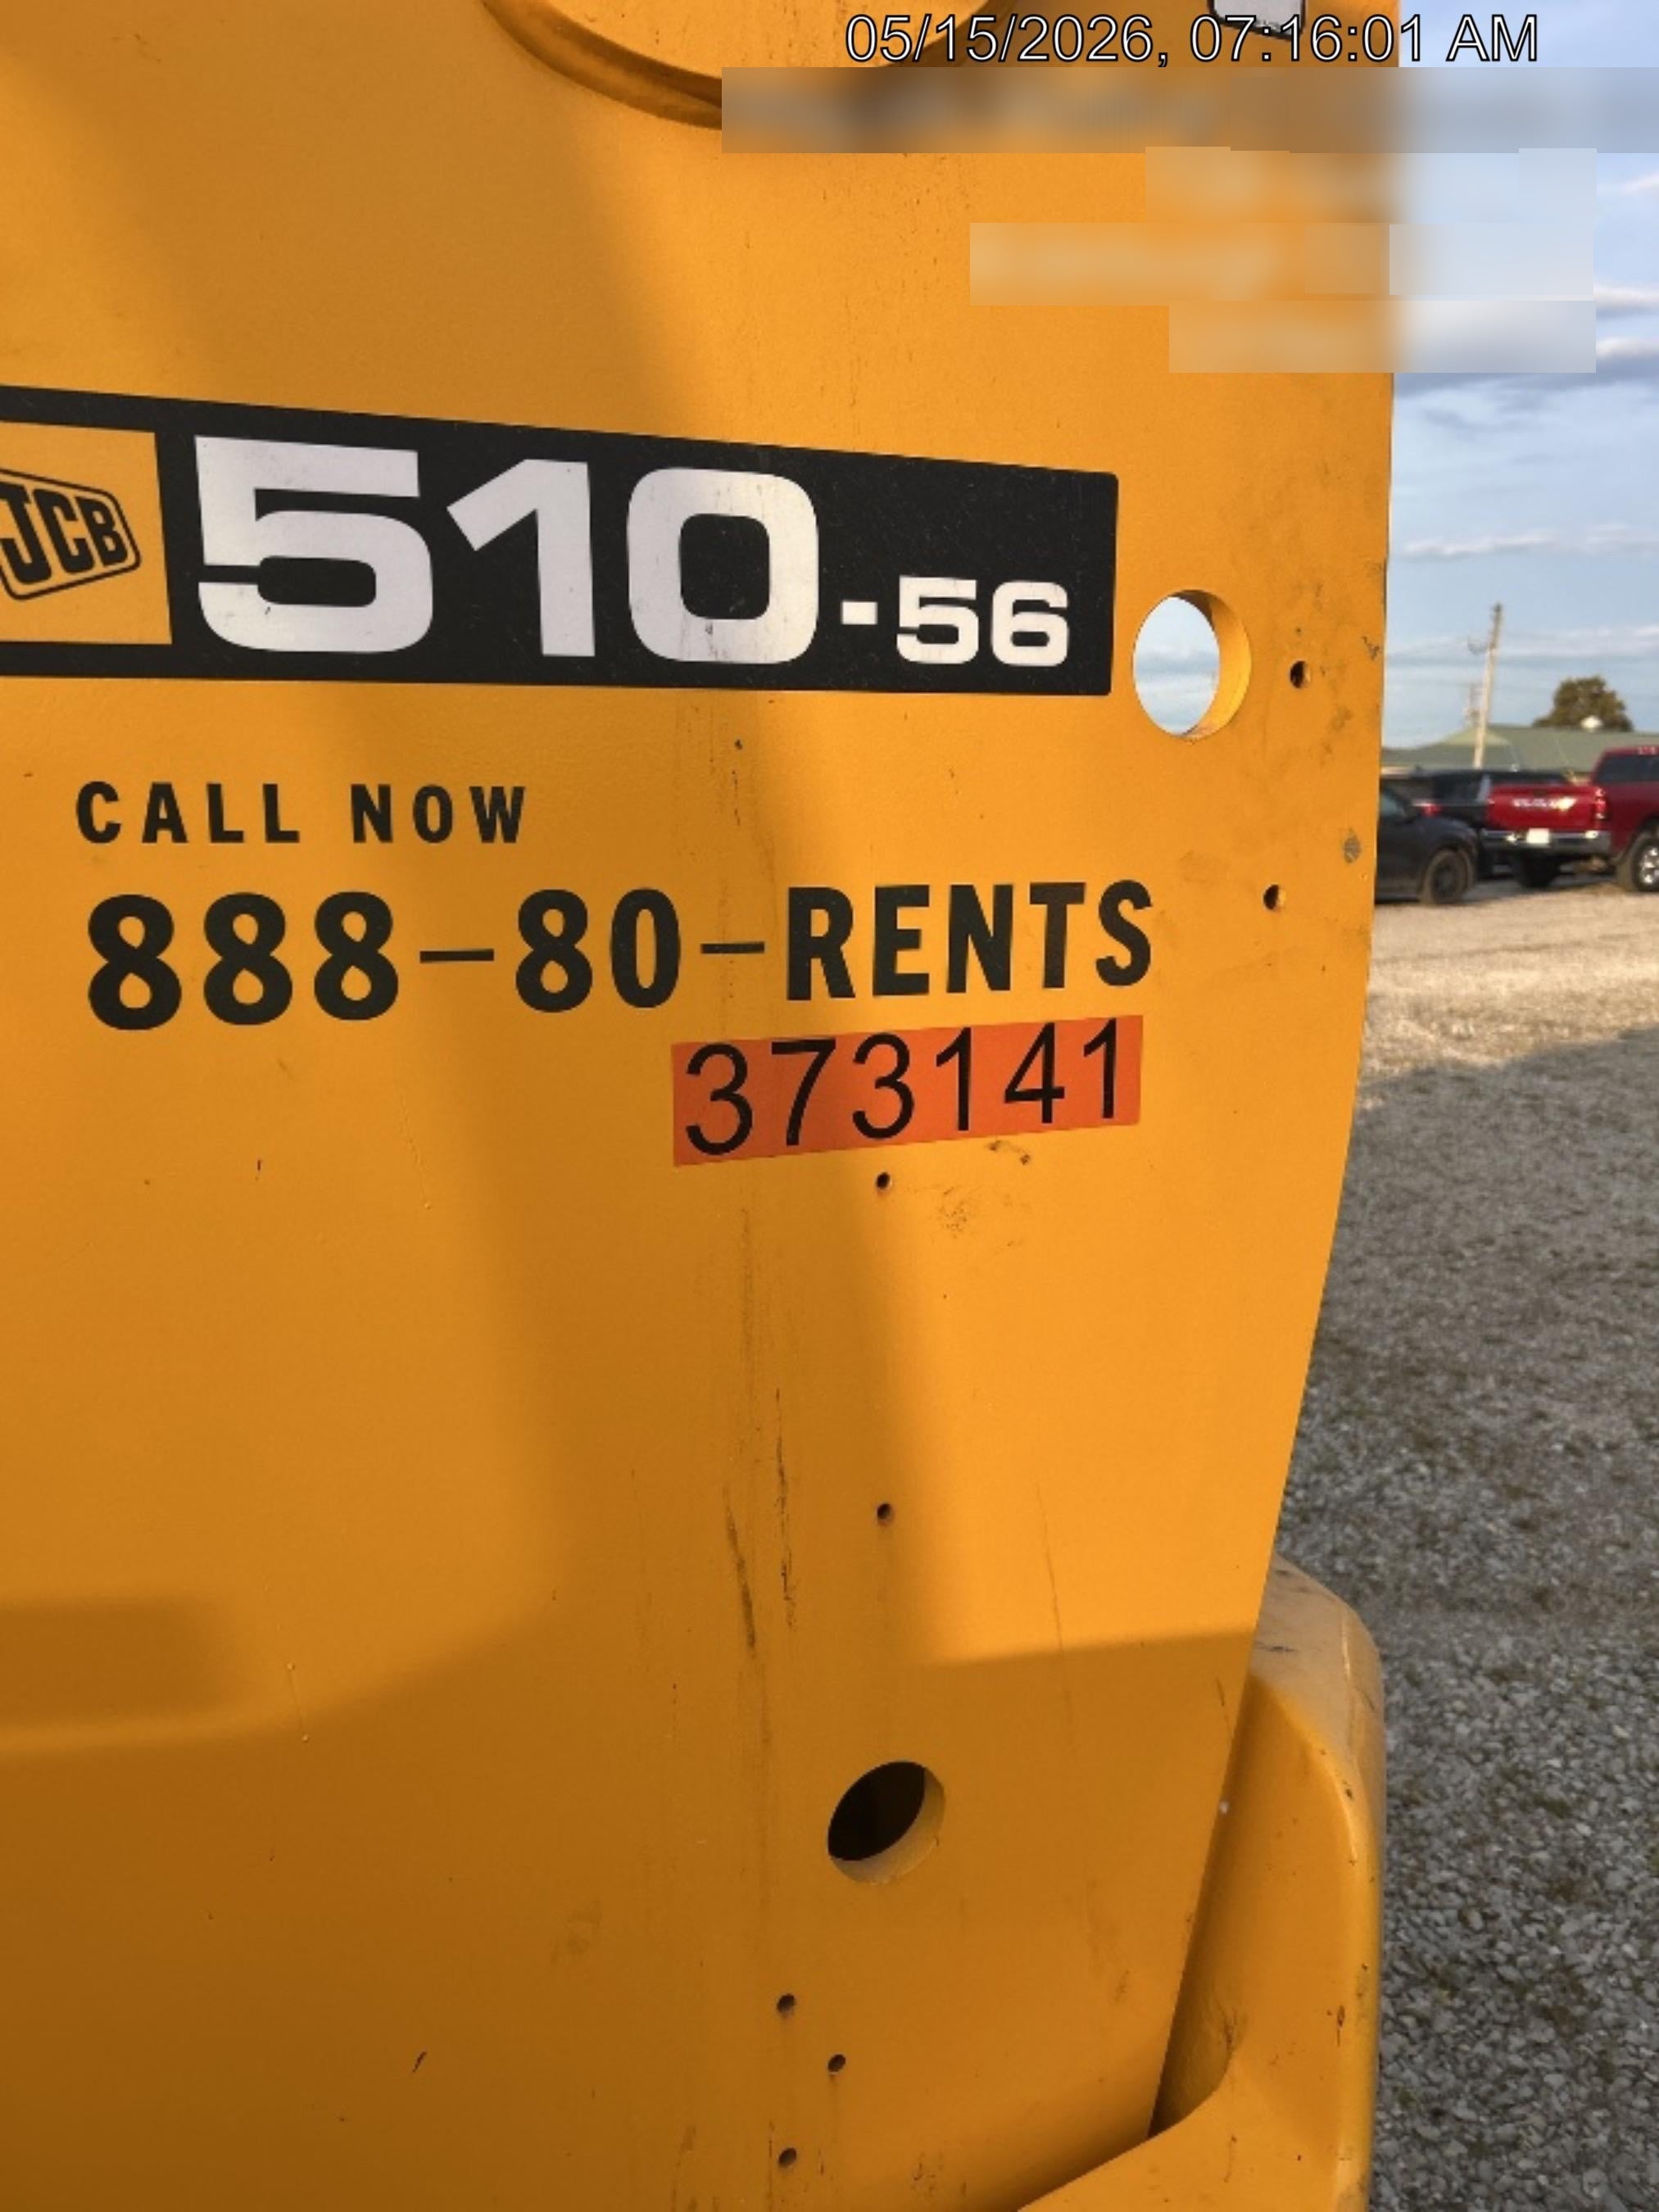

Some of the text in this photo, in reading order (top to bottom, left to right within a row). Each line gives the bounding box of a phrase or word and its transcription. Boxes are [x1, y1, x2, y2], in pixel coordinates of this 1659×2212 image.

[0, 482, 128, 584] JCB
[75, 781, 526, 845] CALL NOW
[686, 1018, 1117, 1155] 373141
